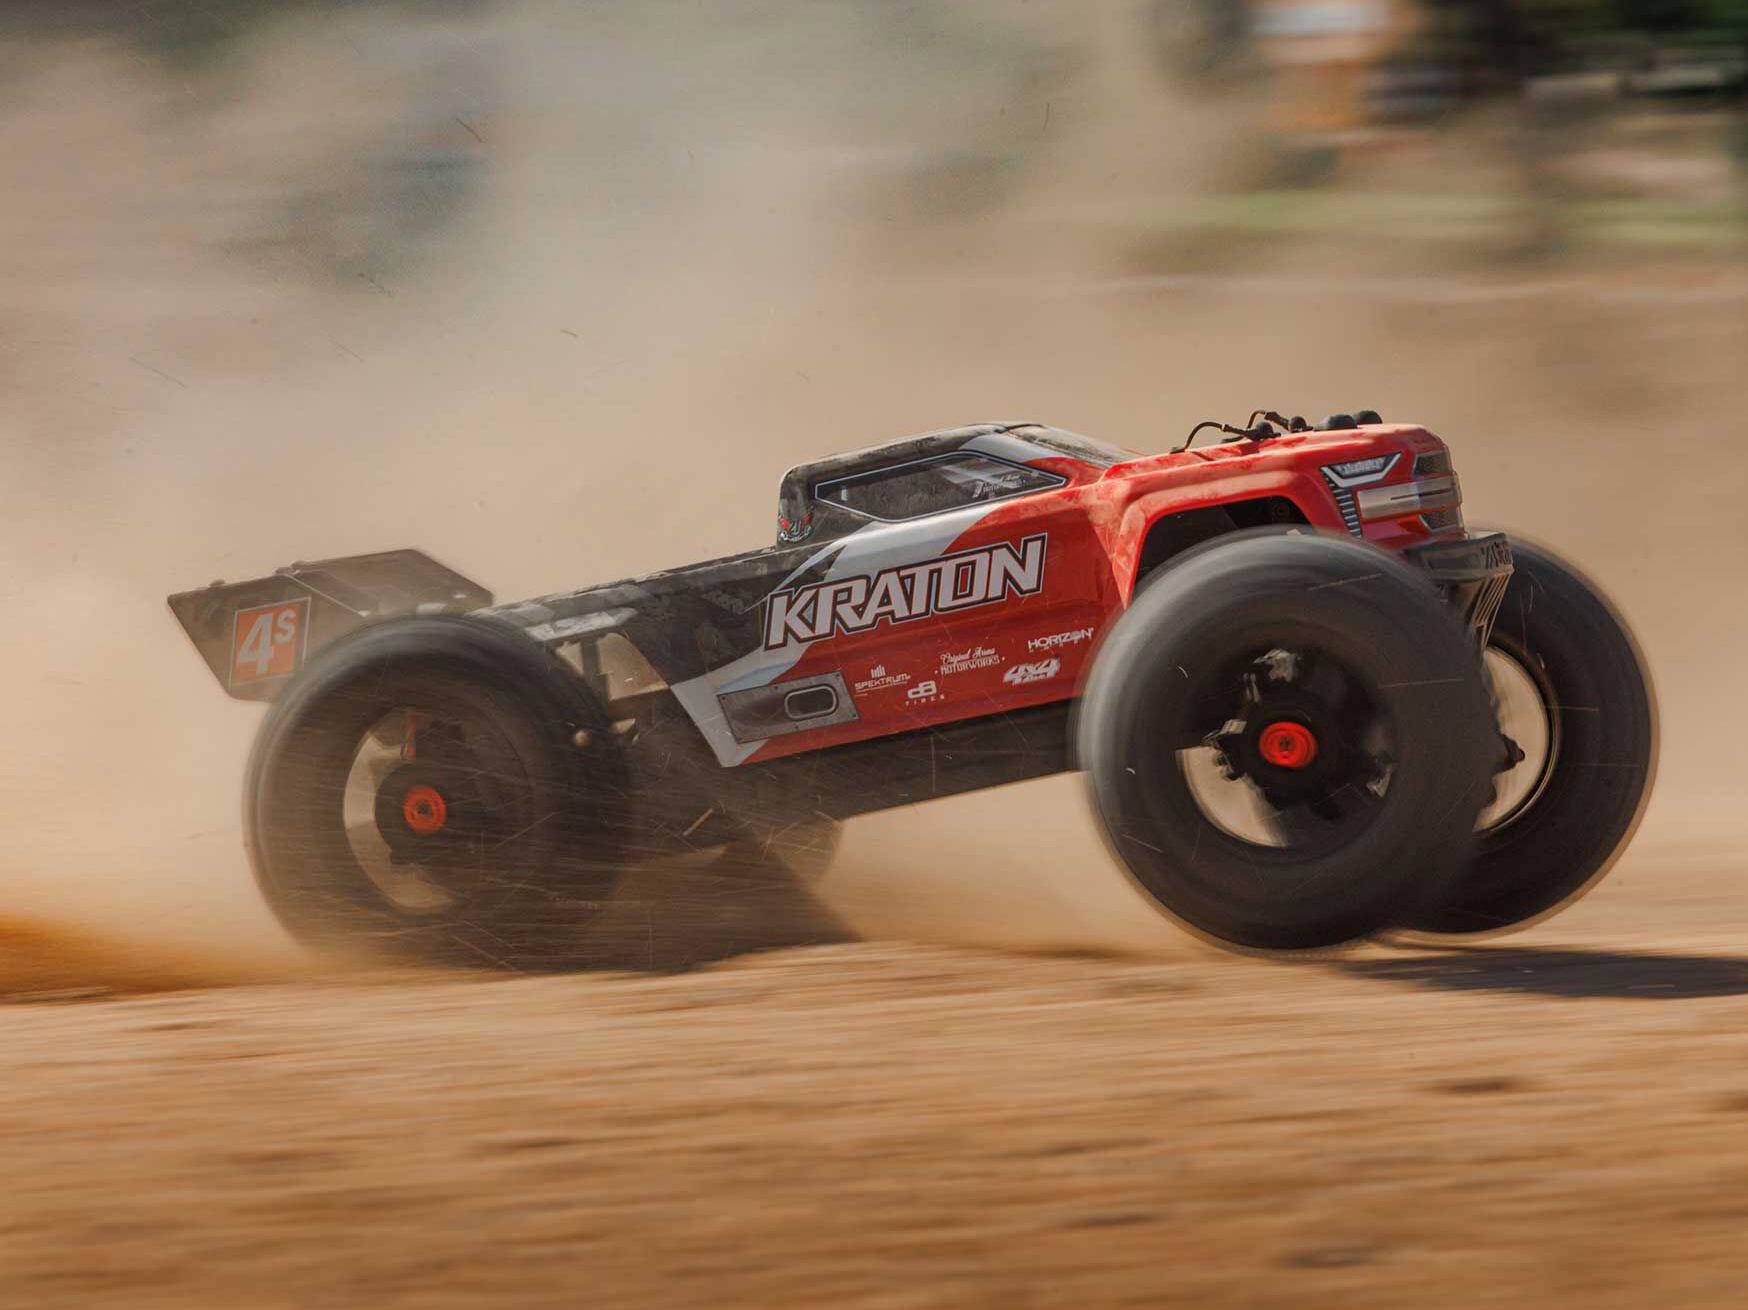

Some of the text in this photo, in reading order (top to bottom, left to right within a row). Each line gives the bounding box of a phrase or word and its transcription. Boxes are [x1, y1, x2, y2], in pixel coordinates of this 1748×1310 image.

[764, 534, 1046, 649] KRATON
[1028, 627, 1094, 650] HORIZON
[940, 654, 1000, 675] MOTORWORKS
[855, 673, 911, 690] SPEKTRUM
